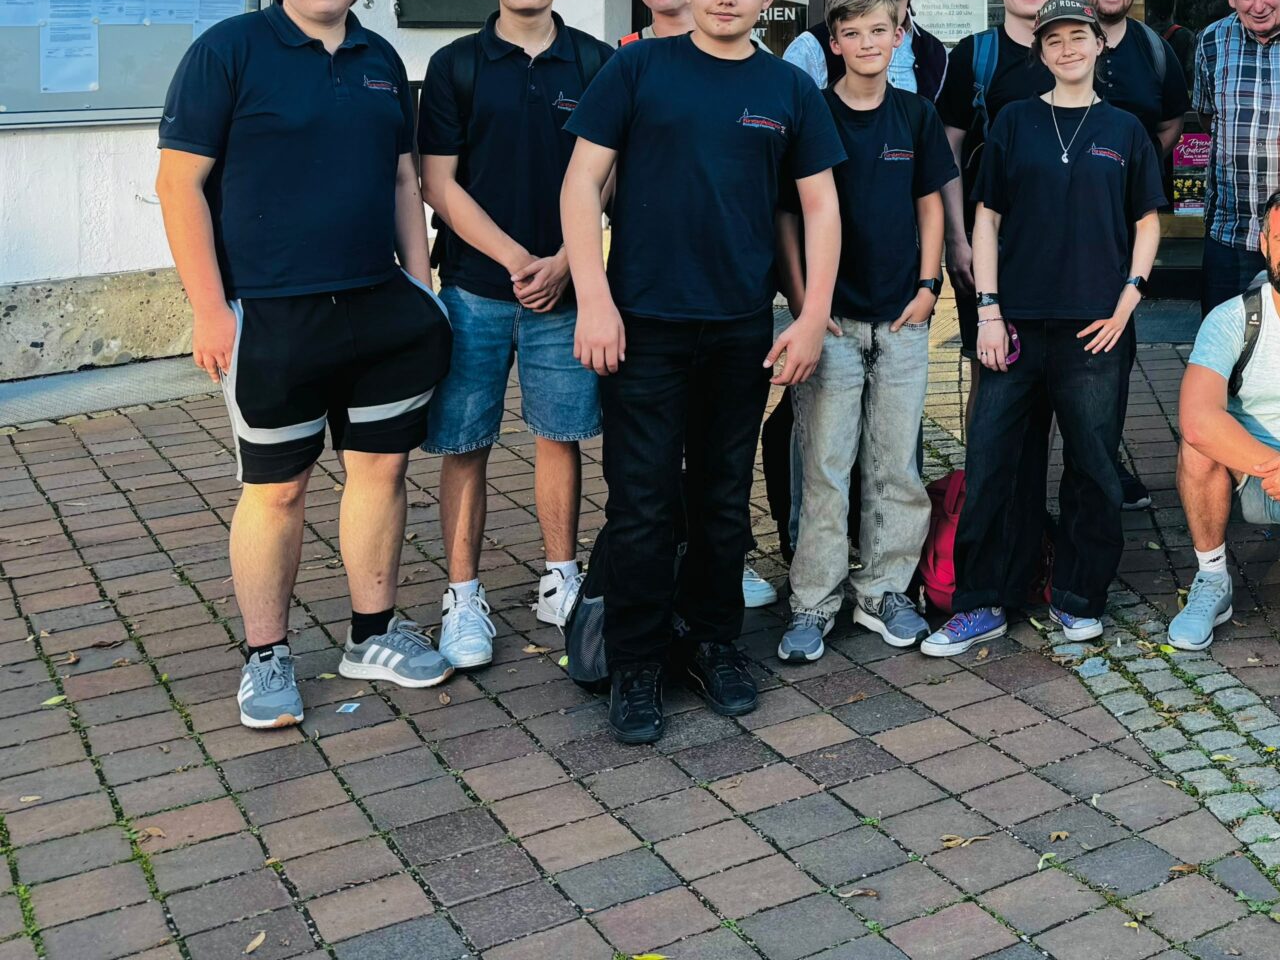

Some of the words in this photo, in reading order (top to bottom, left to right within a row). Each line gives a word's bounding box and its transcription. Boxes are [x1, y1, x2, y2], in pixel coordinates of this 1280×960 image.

[757, 7, 796, 21] RIEN
[1039, 2, 1056, 17] HARD
[1060, 0, 1081, 8] ROCK
